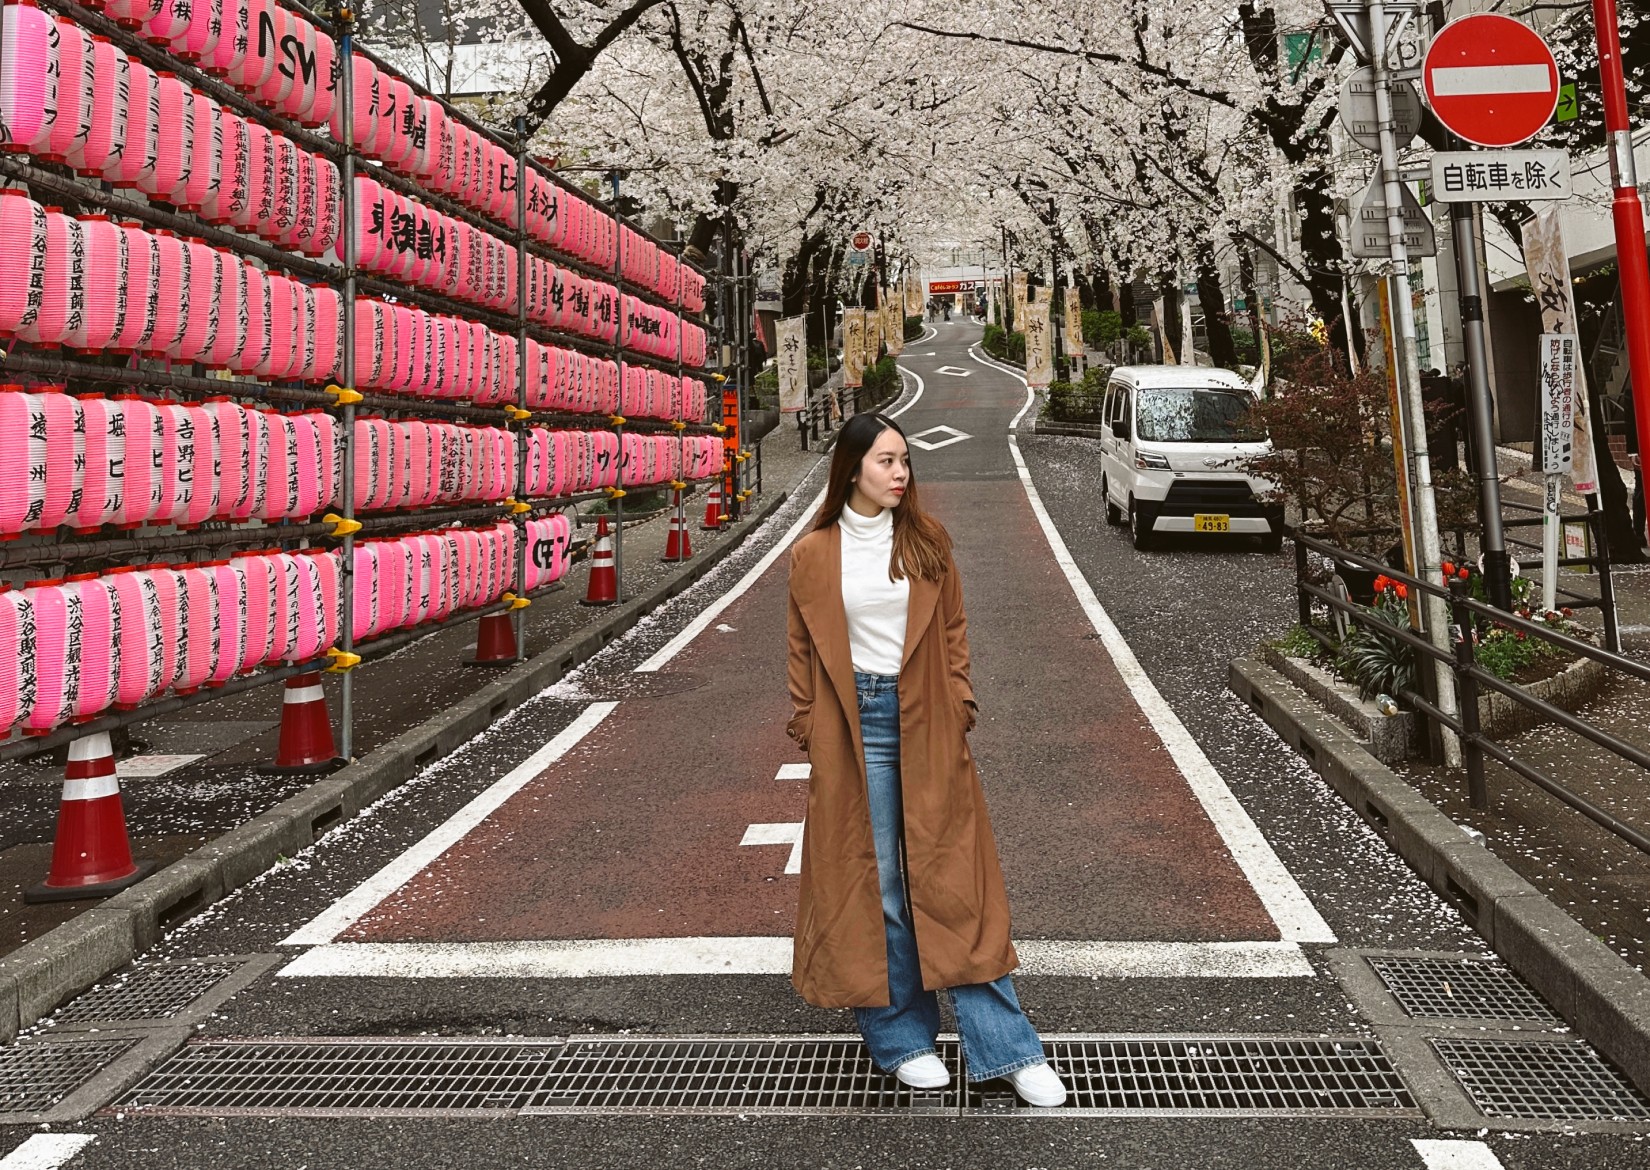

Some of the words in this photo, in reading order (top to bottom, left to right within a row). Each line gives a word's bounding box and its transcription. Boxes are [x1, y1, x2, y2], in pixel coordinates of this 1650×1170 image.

[1443, 161, 1562, 191] 自転車を除く
[20, 206, 48, 325] 渋谷区医師会
[65, 221, 84, 331] 渋谷区医師会
[849, 322, 860, 370] 桜まつり
[1562, 339, 1573, 428] 自転車は歩行者の通行の
[21, 412, 47, 522] 遠州屋
[103, 413, 126, 512] 堀ビル
[175, 418, 195, 503] 吉野ビル
[1202, 521, 1228, 531] 49-83
[55, 594, 84, 719] 渋谷区観光協会
